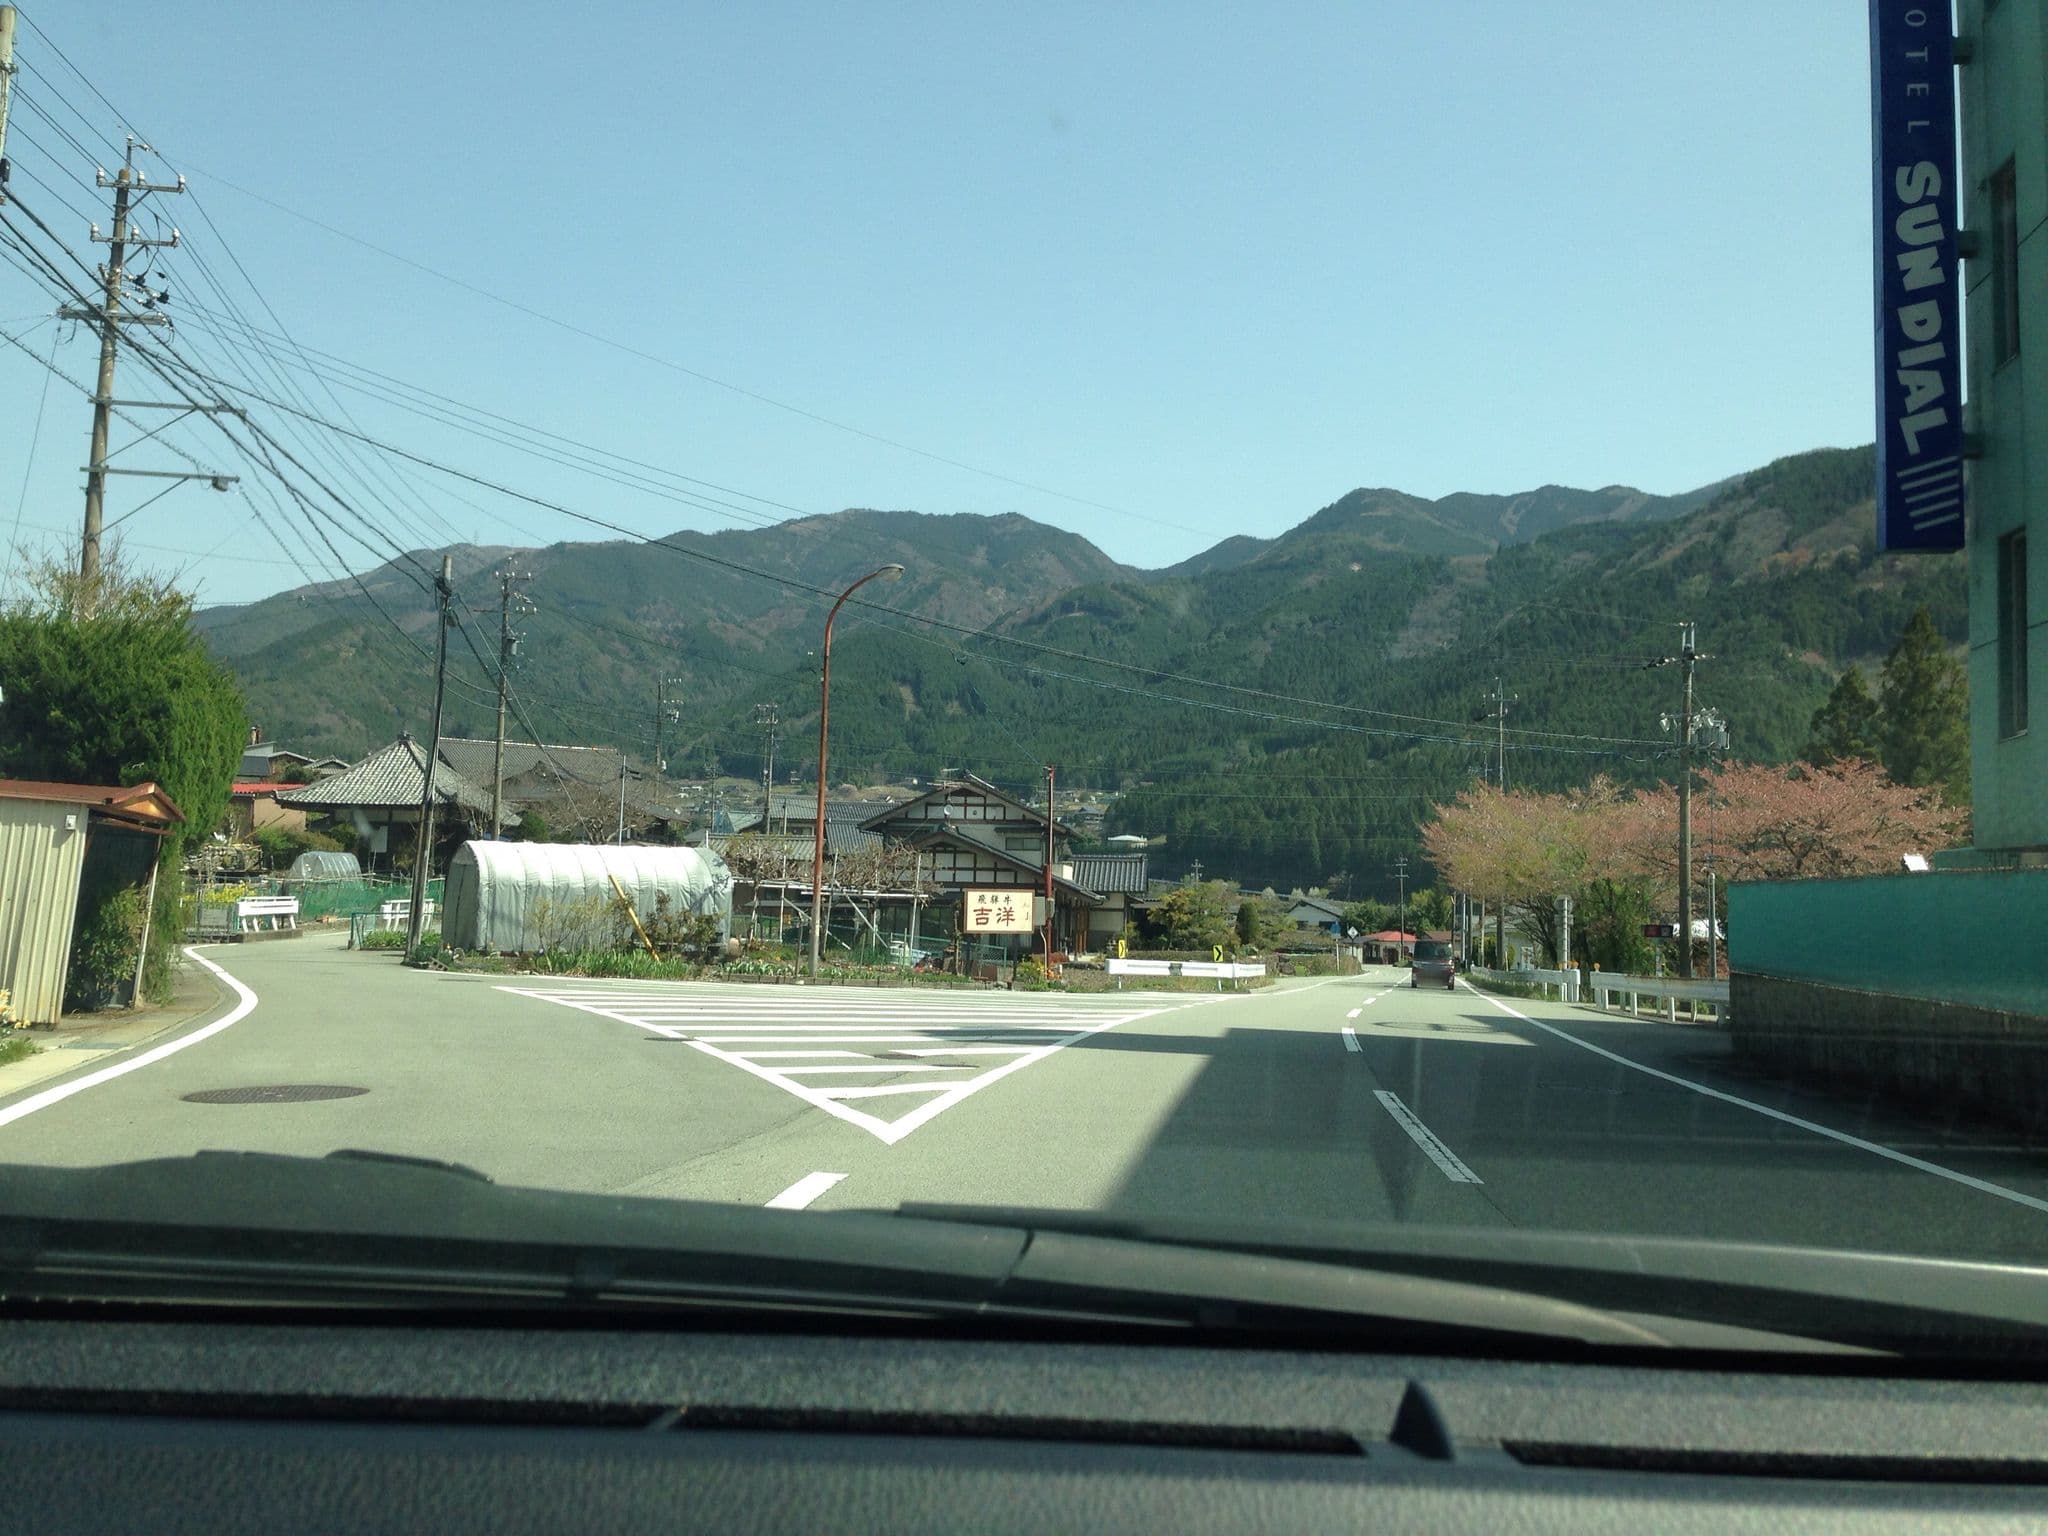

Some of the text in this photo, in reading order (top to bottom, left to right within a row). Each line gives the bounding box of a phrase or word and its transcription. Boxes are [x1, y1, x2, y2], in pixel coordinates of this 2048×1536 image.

[1895, 161, 1946, 292] SUN
[1896, 299, 1948, 456] DIAL
[973, 906, 1016, 927] 吉洋
